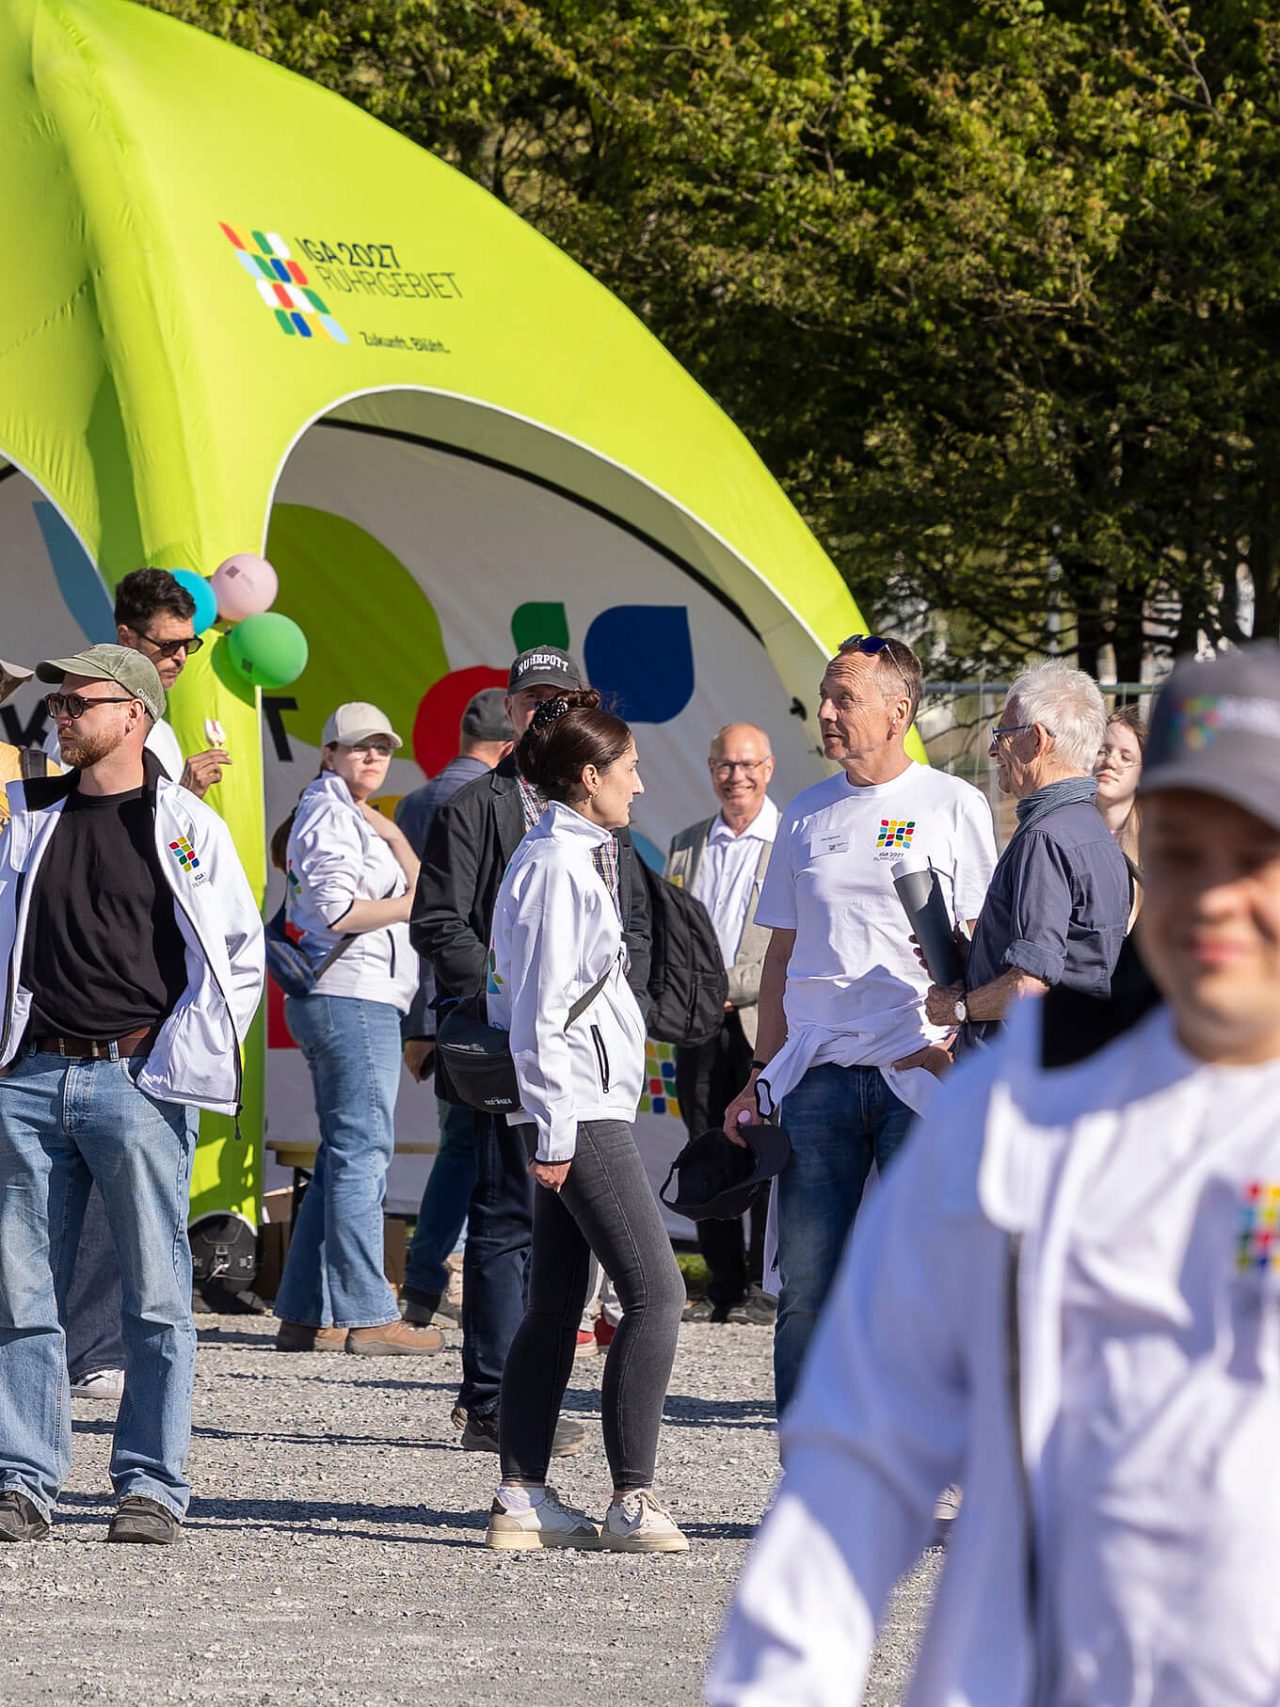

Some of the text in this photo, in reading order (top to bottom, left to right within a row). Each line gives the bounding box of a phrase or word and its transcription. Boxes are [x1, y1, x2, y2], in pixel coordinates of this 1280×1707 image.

[294, 237, 401, 269] IGA 2027
[315, 265, 463, 299] RUHRGEBIET
[518, 654, 569, 676] RUHRPOTT
